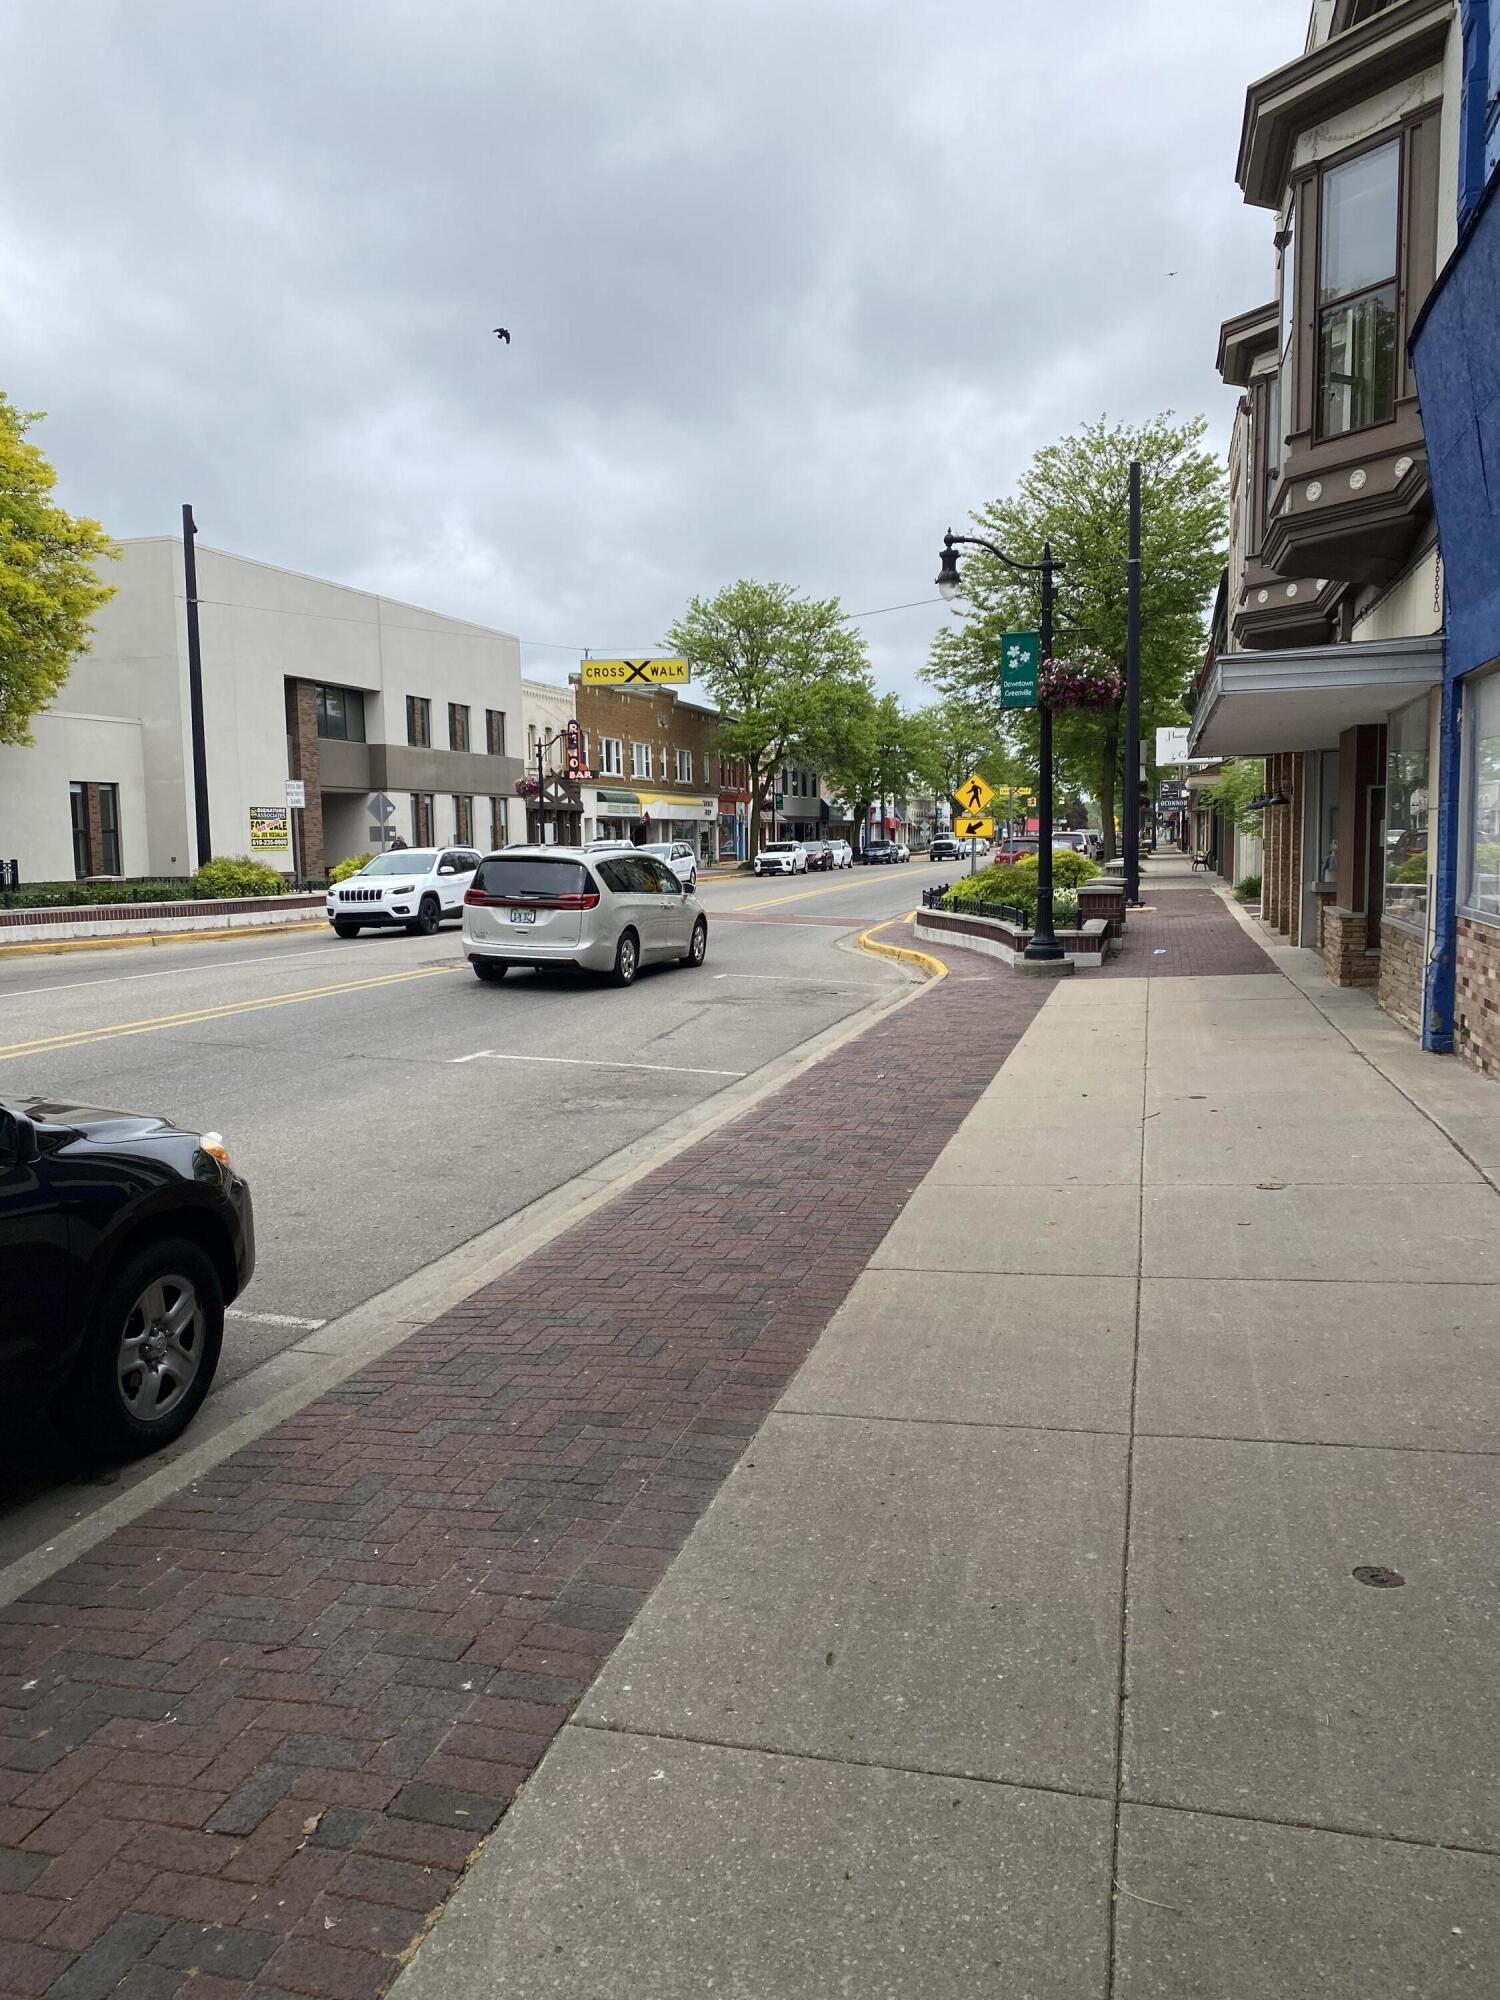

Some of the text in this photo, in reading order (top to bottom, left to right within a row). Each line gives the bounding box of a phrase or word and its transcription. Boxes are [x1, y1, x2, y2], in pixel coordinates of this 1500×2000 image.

[586, 667, 625, 678] CROSS
[650, 665, 684, 676] WALK
[1003, 680, 1034, 688] Downtown
[1004, 689, 1032, 697] Greenville
[569, 770, 593, 779] BAR
